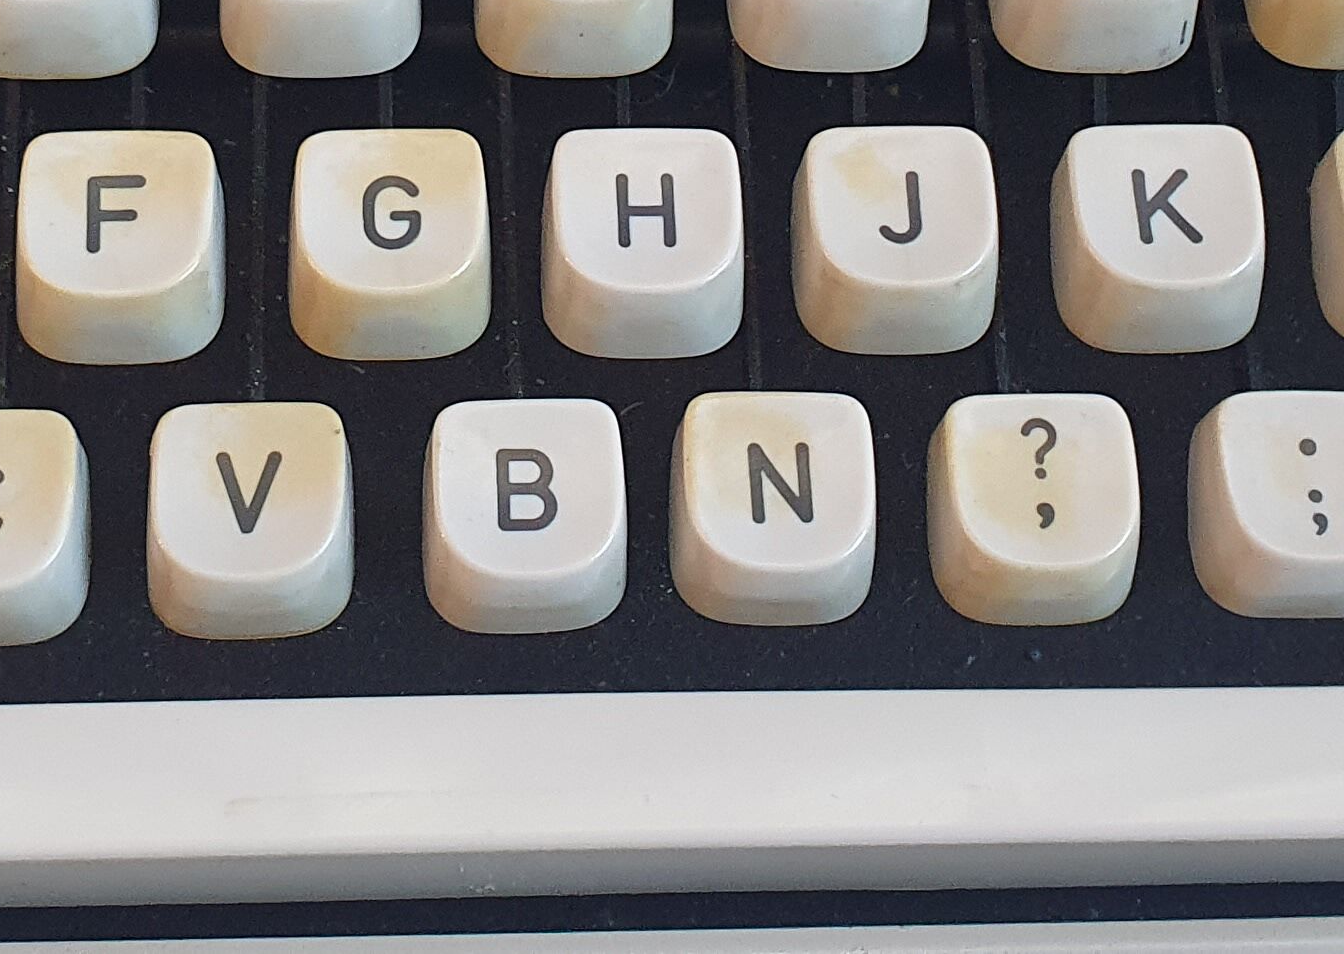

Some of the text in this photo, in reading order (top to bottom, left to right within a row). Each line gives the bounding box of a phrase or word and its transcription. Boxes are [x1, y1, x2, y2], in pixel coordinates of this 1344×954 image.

[84, 173, 148, 256] F
[360, 173, 423, 252] G
[614, 171, 679, 250] H
[877, 169, 924, 246] J
[1129, 167, 1205, 246] K
[745, 440, 816, 526] N
[1019, 416, 1059, 481] ?
[214, 449, 284, 536] V
[494, 447, 560, 533] B
[1035, 501, 1057, 531] ,
[1306, 487, 1330, 538] ;
